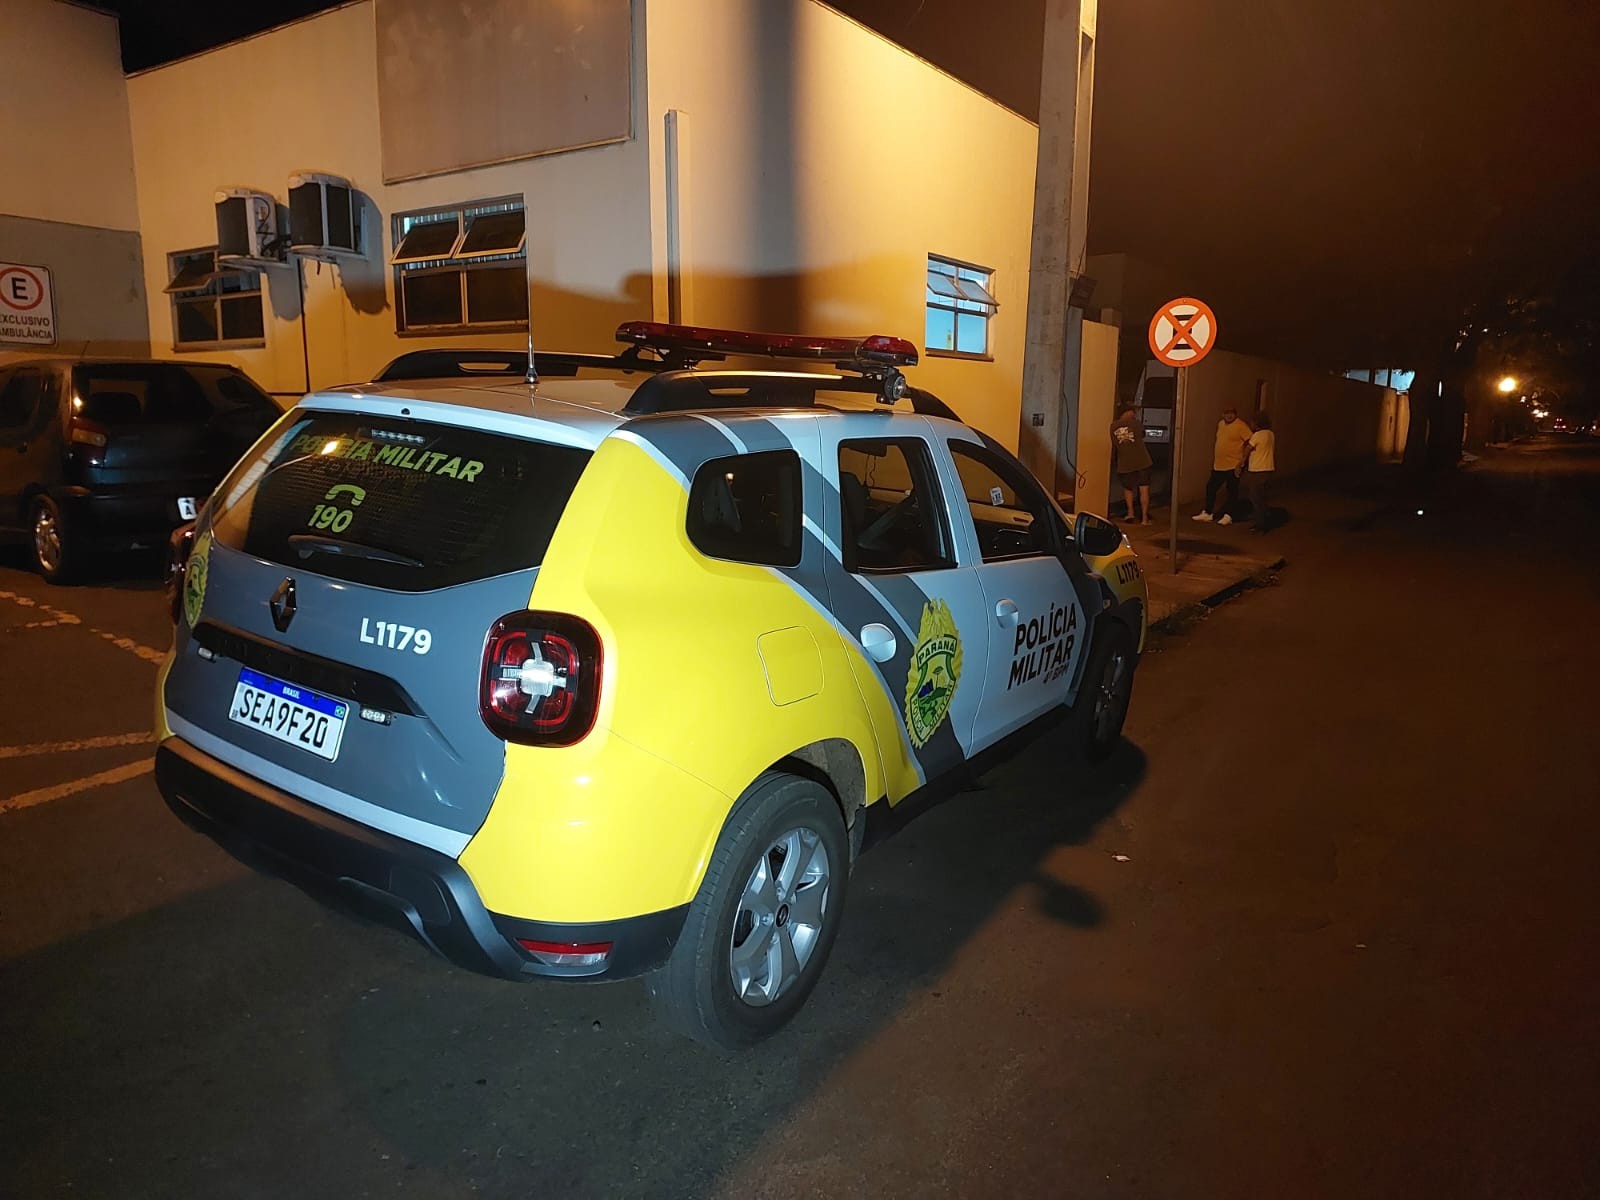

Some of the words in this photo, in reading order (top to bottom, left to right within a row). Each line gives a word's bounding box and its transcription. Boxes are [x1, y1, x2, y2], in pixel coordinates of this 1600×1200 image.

[11, 276, 28, 300] E
[0, 327, 53, 339] MBULÂNCIA
[373, 443, 484, 482] MILITAR
[307, 505, 354, 533] 190
[360, 617, 432, 655] L1179
[1014, 602, 1077, 656] POLÍCIA
[918, 640, 955, 665] PARANÁ
[1007, 634, 1075, 691] MILITAR
[282, 686, 301, 699] BRASIL
[239, 689, 329, 749] SEA9F20
